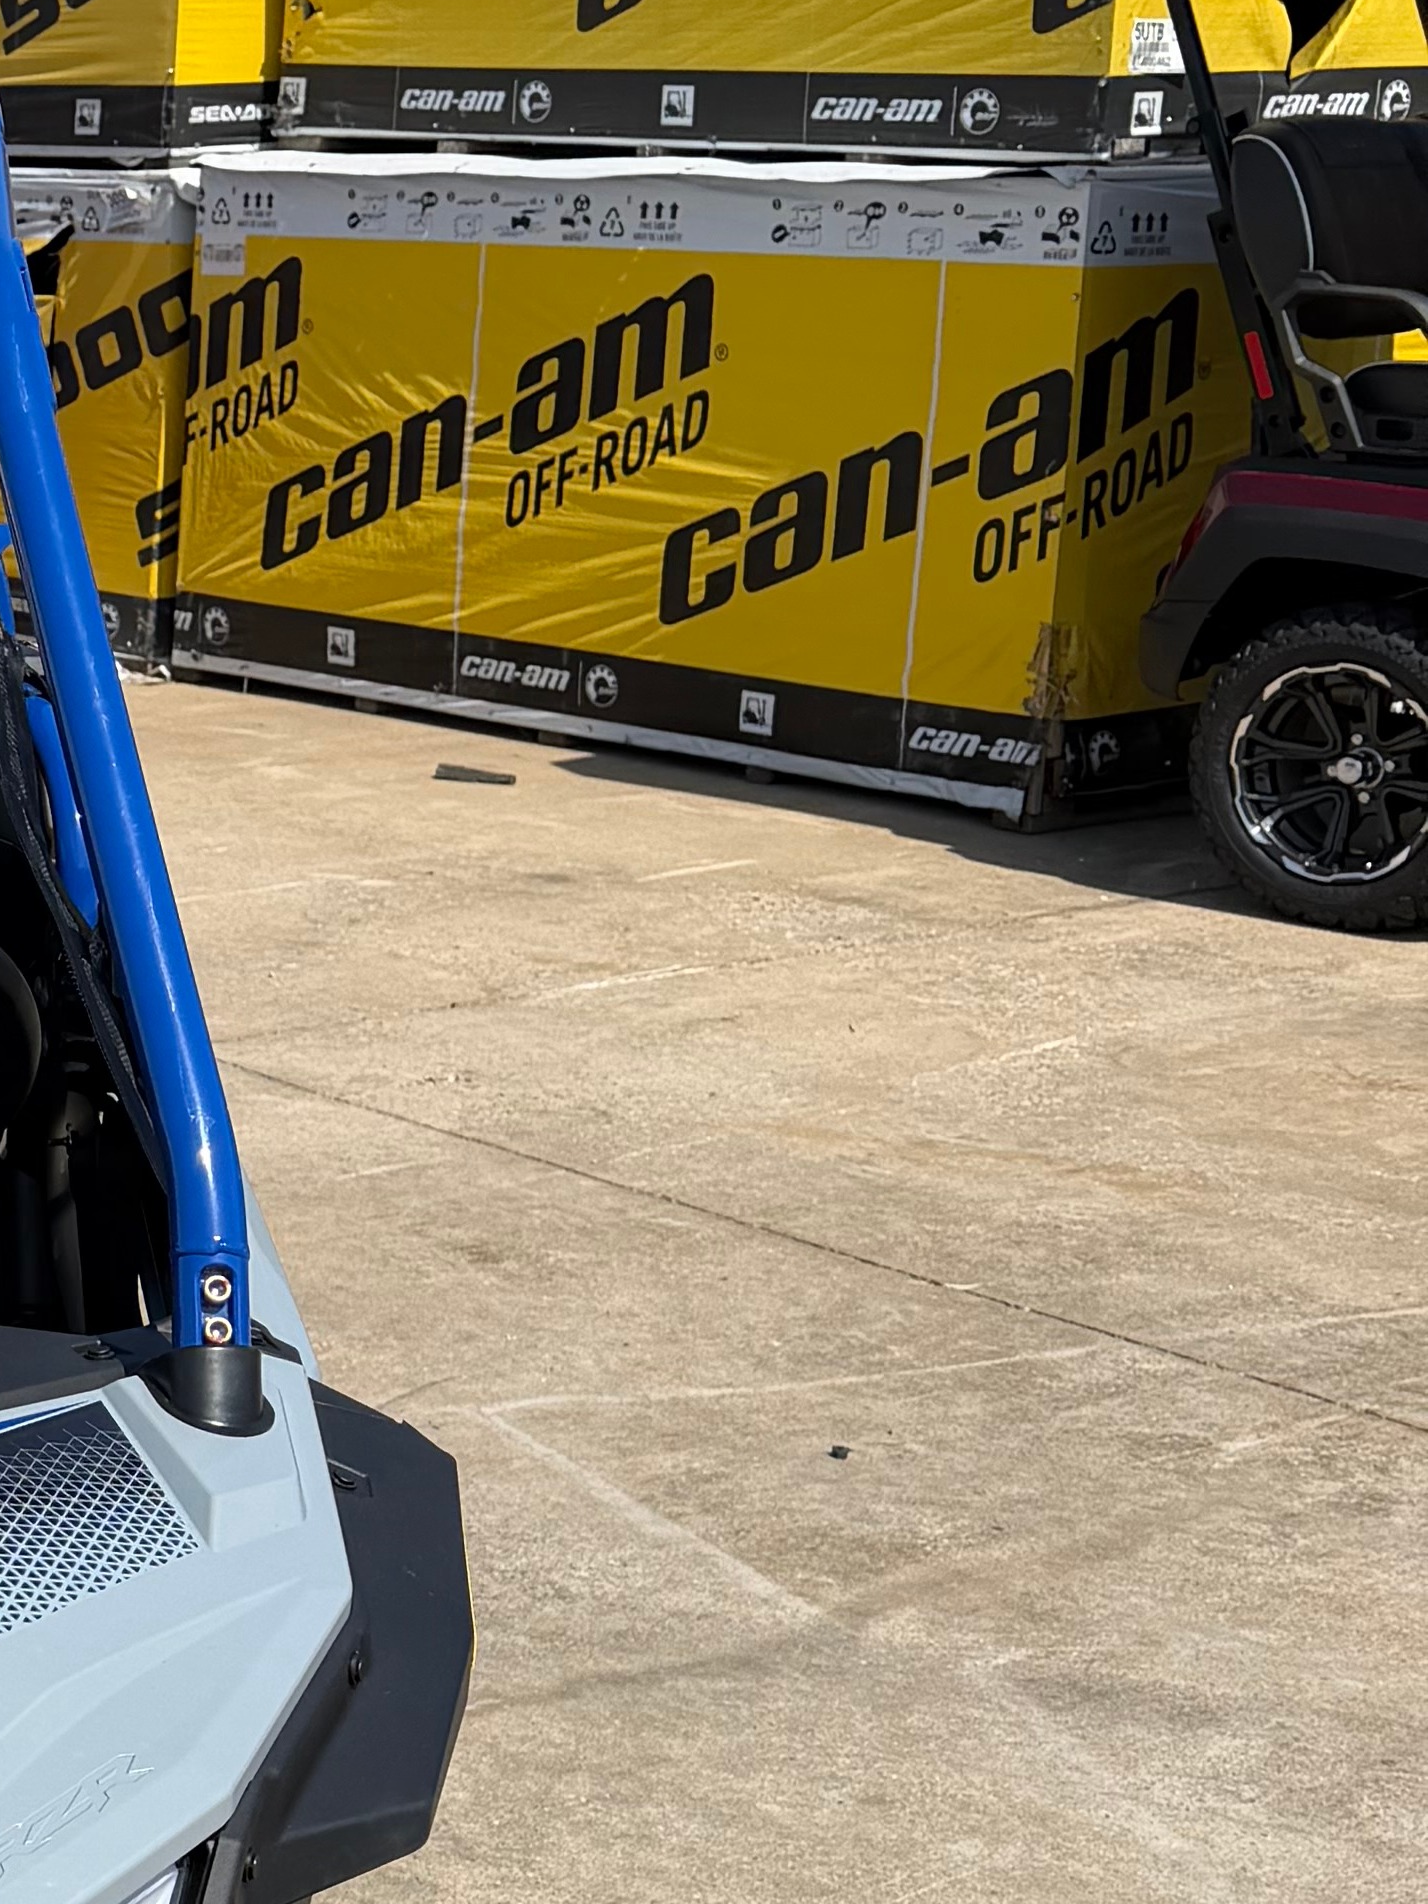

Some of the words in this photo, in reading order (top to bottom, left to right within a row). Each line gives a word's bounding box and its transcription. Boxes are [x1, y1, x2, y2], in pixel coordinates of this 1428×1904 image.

[400, 87, 507, 112] can-am
[810, 96, 944, 123] can-am
[1263, 90, 1370, 119] can-am
[184, 360, 299, 465] F-ROAD
[260, 273, 715, 570] can-am
[505, 390, 710, 528] OFF-ROAD
[659, 287, 1200, 625] can-am
[972, 412, 1194, 584] OFF-ROAD
[460, 654, 571, 693] can-am
